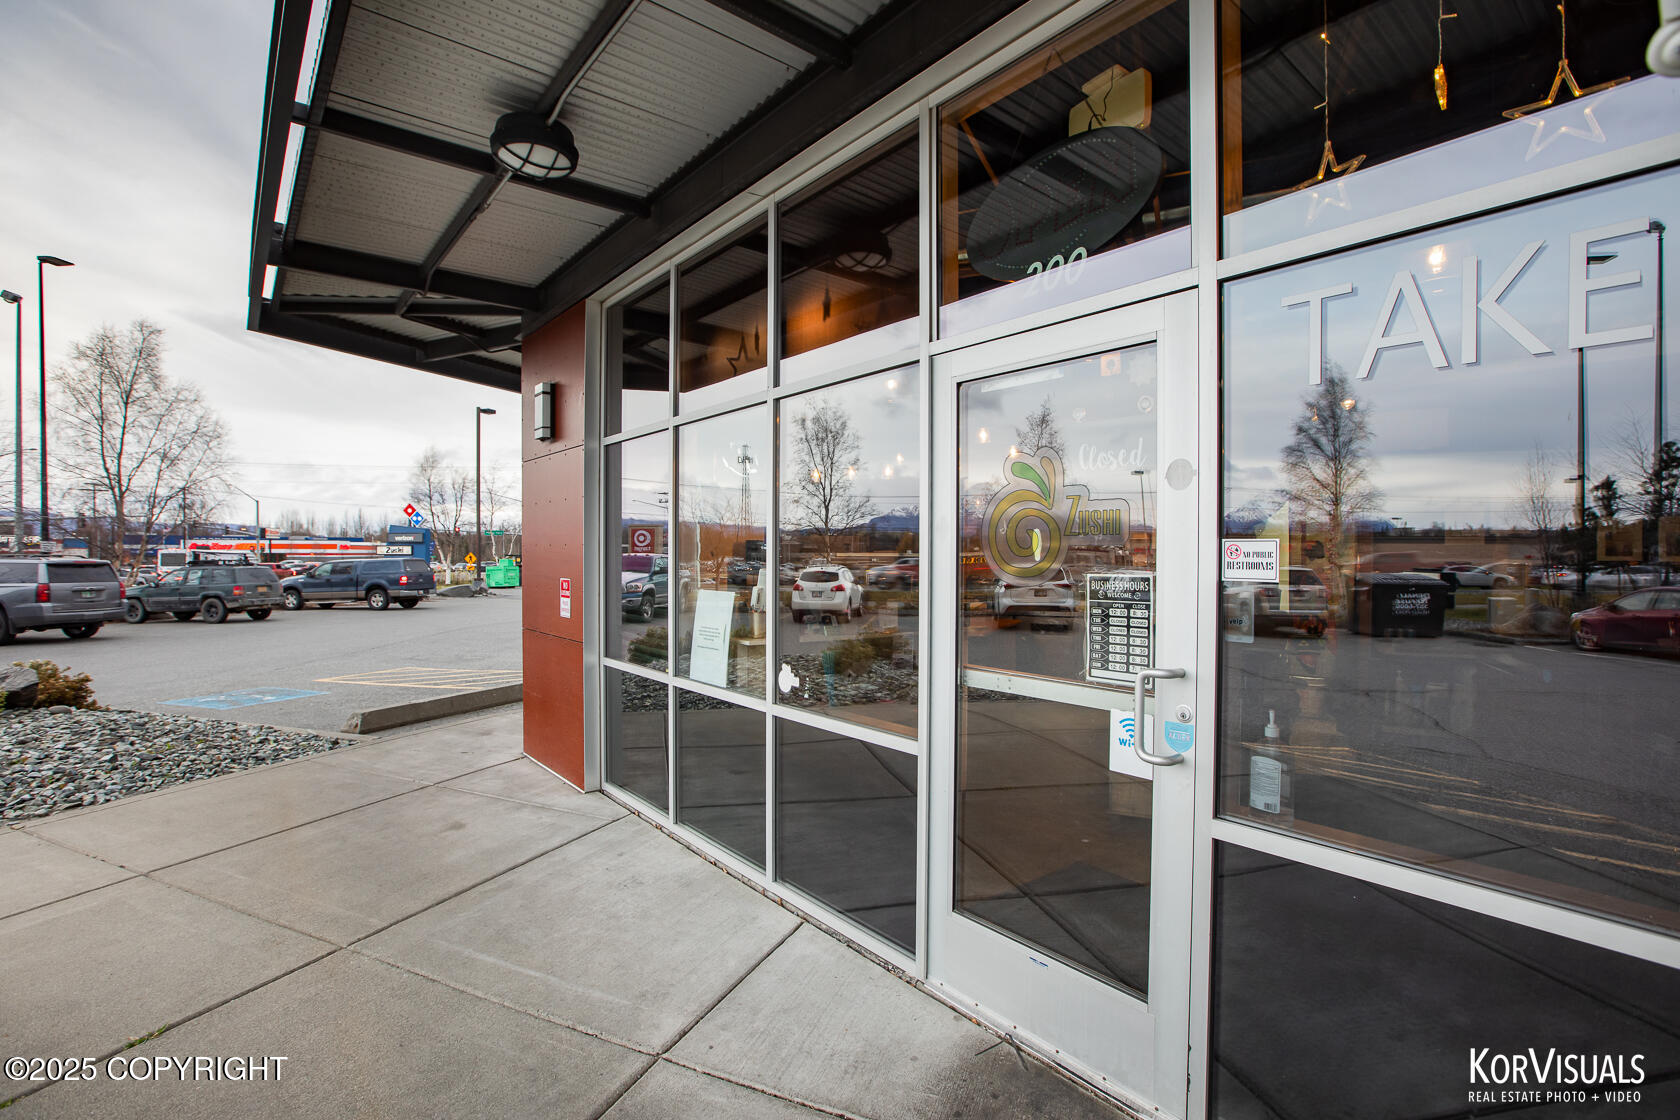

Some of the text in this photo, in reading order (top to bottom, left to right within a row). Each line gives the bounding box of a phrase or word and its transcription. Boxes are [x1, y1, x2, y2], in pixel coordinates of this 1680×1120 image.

[1024, 247, 1088, 297] 200
[1281, 216, 1654, 385] TAKE
[1079, 437, 1146, 470] Closed
[1063, 494, 1121, 536] ZUSHI
[1226, 561, 1274, 571] RESTROOMS
[1252, 551, 1274, 559] PUBLIC
[1091, 580, 1149, 592] BUSINESS HOURS
[1229, 617, 1244, 626] yelp
